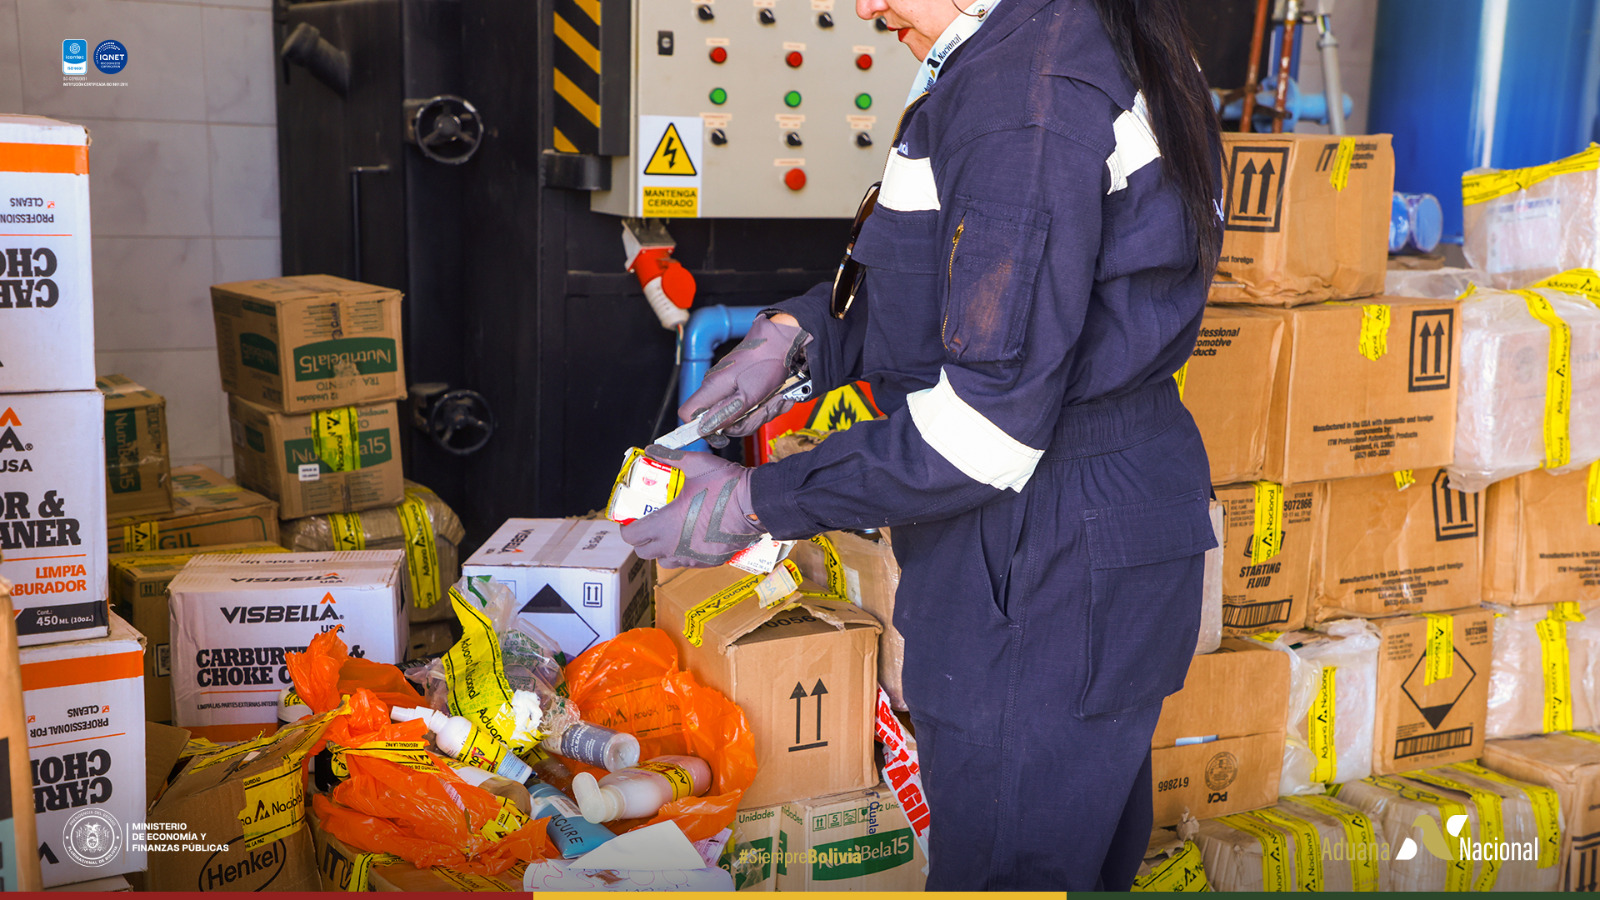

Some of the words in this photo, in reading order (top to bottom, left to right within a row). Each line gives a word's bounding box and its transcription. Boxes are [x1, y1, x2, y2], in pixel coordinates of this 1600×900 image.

[937, 33, 962, 62] Nacional
[644, 189, 697, 198] MANTENGA
[9, 198, 44, 207] CLEANS
[647, 199, 695, 207] CERRADO
[0, 247, 58, 278] CH
[0, 491, 30, 520] R
[38, 490, 65, 518] &
[1266, 489, 1276, 532] Nacional
[35, 564, 87, 579] LIMPIA
[1239, 562, 1282, 578] STARTING
[230, 575, 340, 583] VISBELLA
[1246, 576, 1272, 589] FLUID
[723, 577, 759, 601] Aduana
[36, 615, 58, 627] 450
[197, 666, 273, 688] CHOKE
[66, 704, 100, 718] CLEANS
[30, 726, 48, 738] FOR
[48, 717, 110, 736] PROFESSIONAL
[1158, 776, 1190, 792] 612866
[738, 809, 775, 824] Unidades
[868, 801, 881, 835] Quala
[551, 814, 584, 845] ACURE
[206, 841, 280, 890] Henkel
